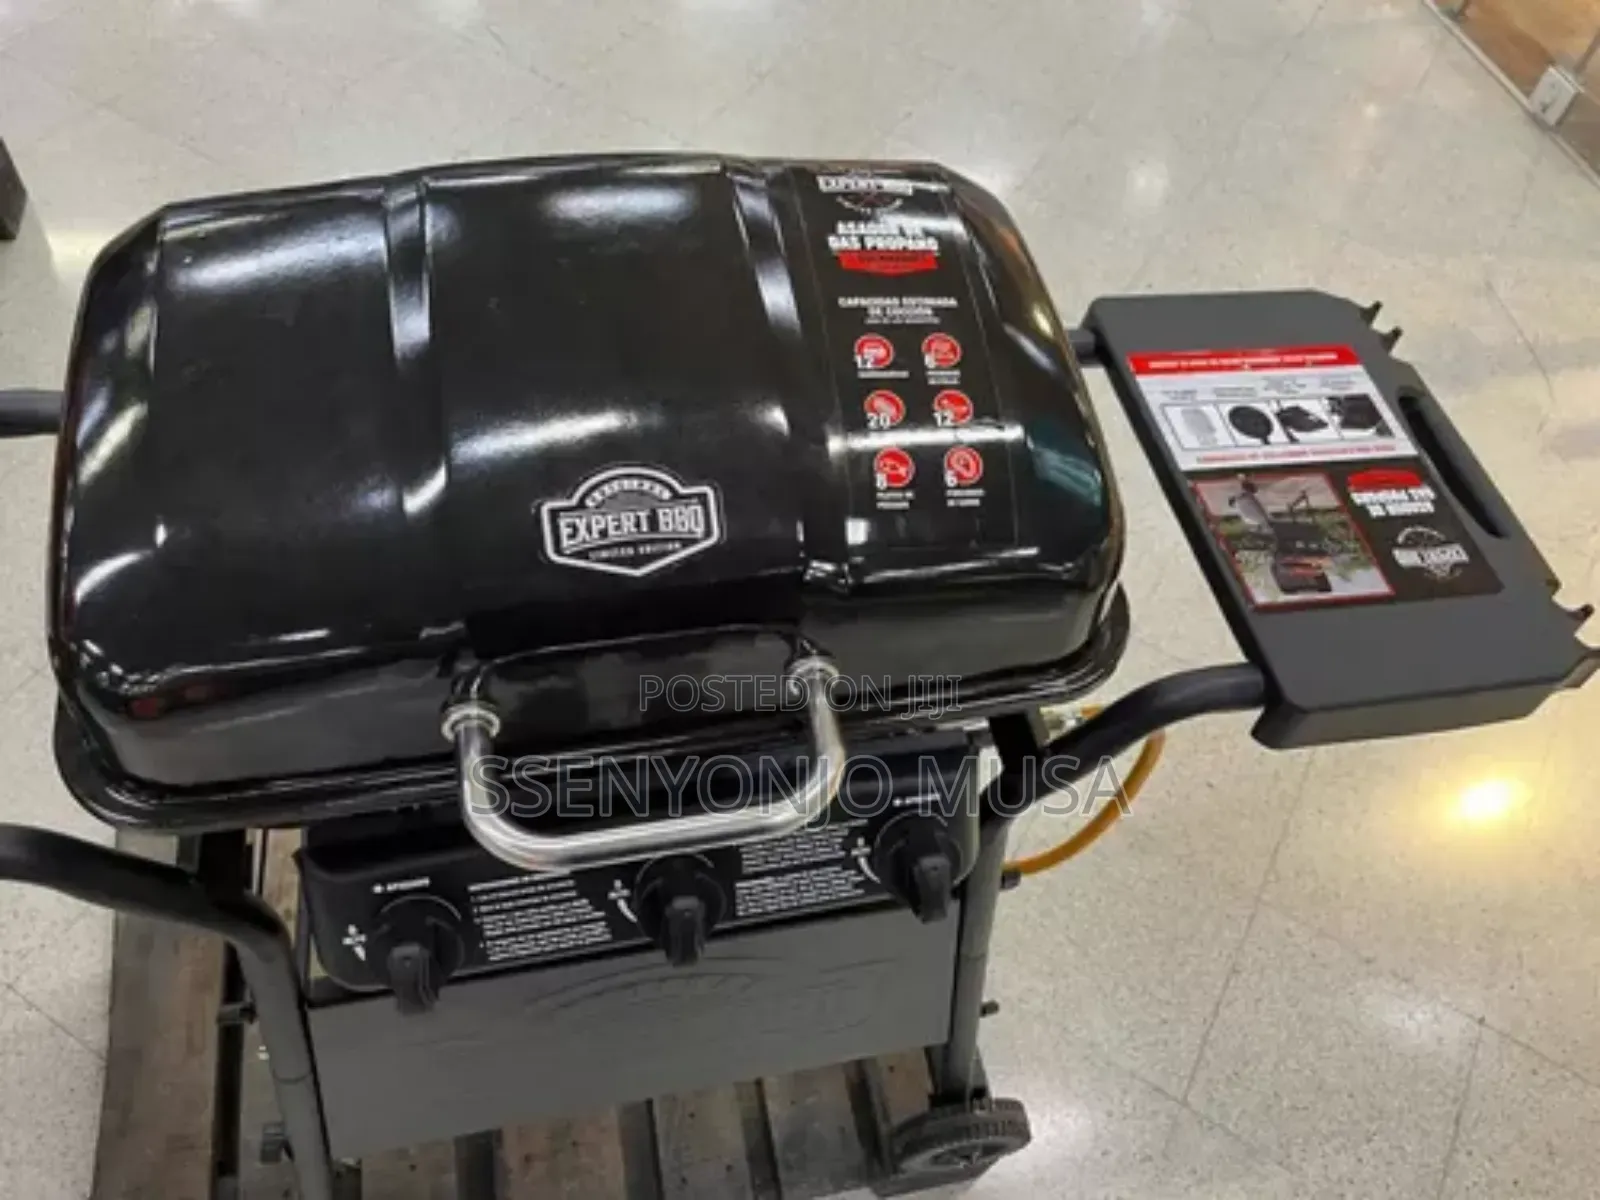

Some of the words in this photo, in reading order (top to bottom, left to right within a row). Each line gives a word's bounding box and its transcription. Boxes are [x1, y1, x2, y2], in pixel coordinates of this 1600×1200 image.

[867, 412, 891, 430] 20
[558, 511, 649, 549] EXPERT
[656, 503, 705, 536] BBQ
